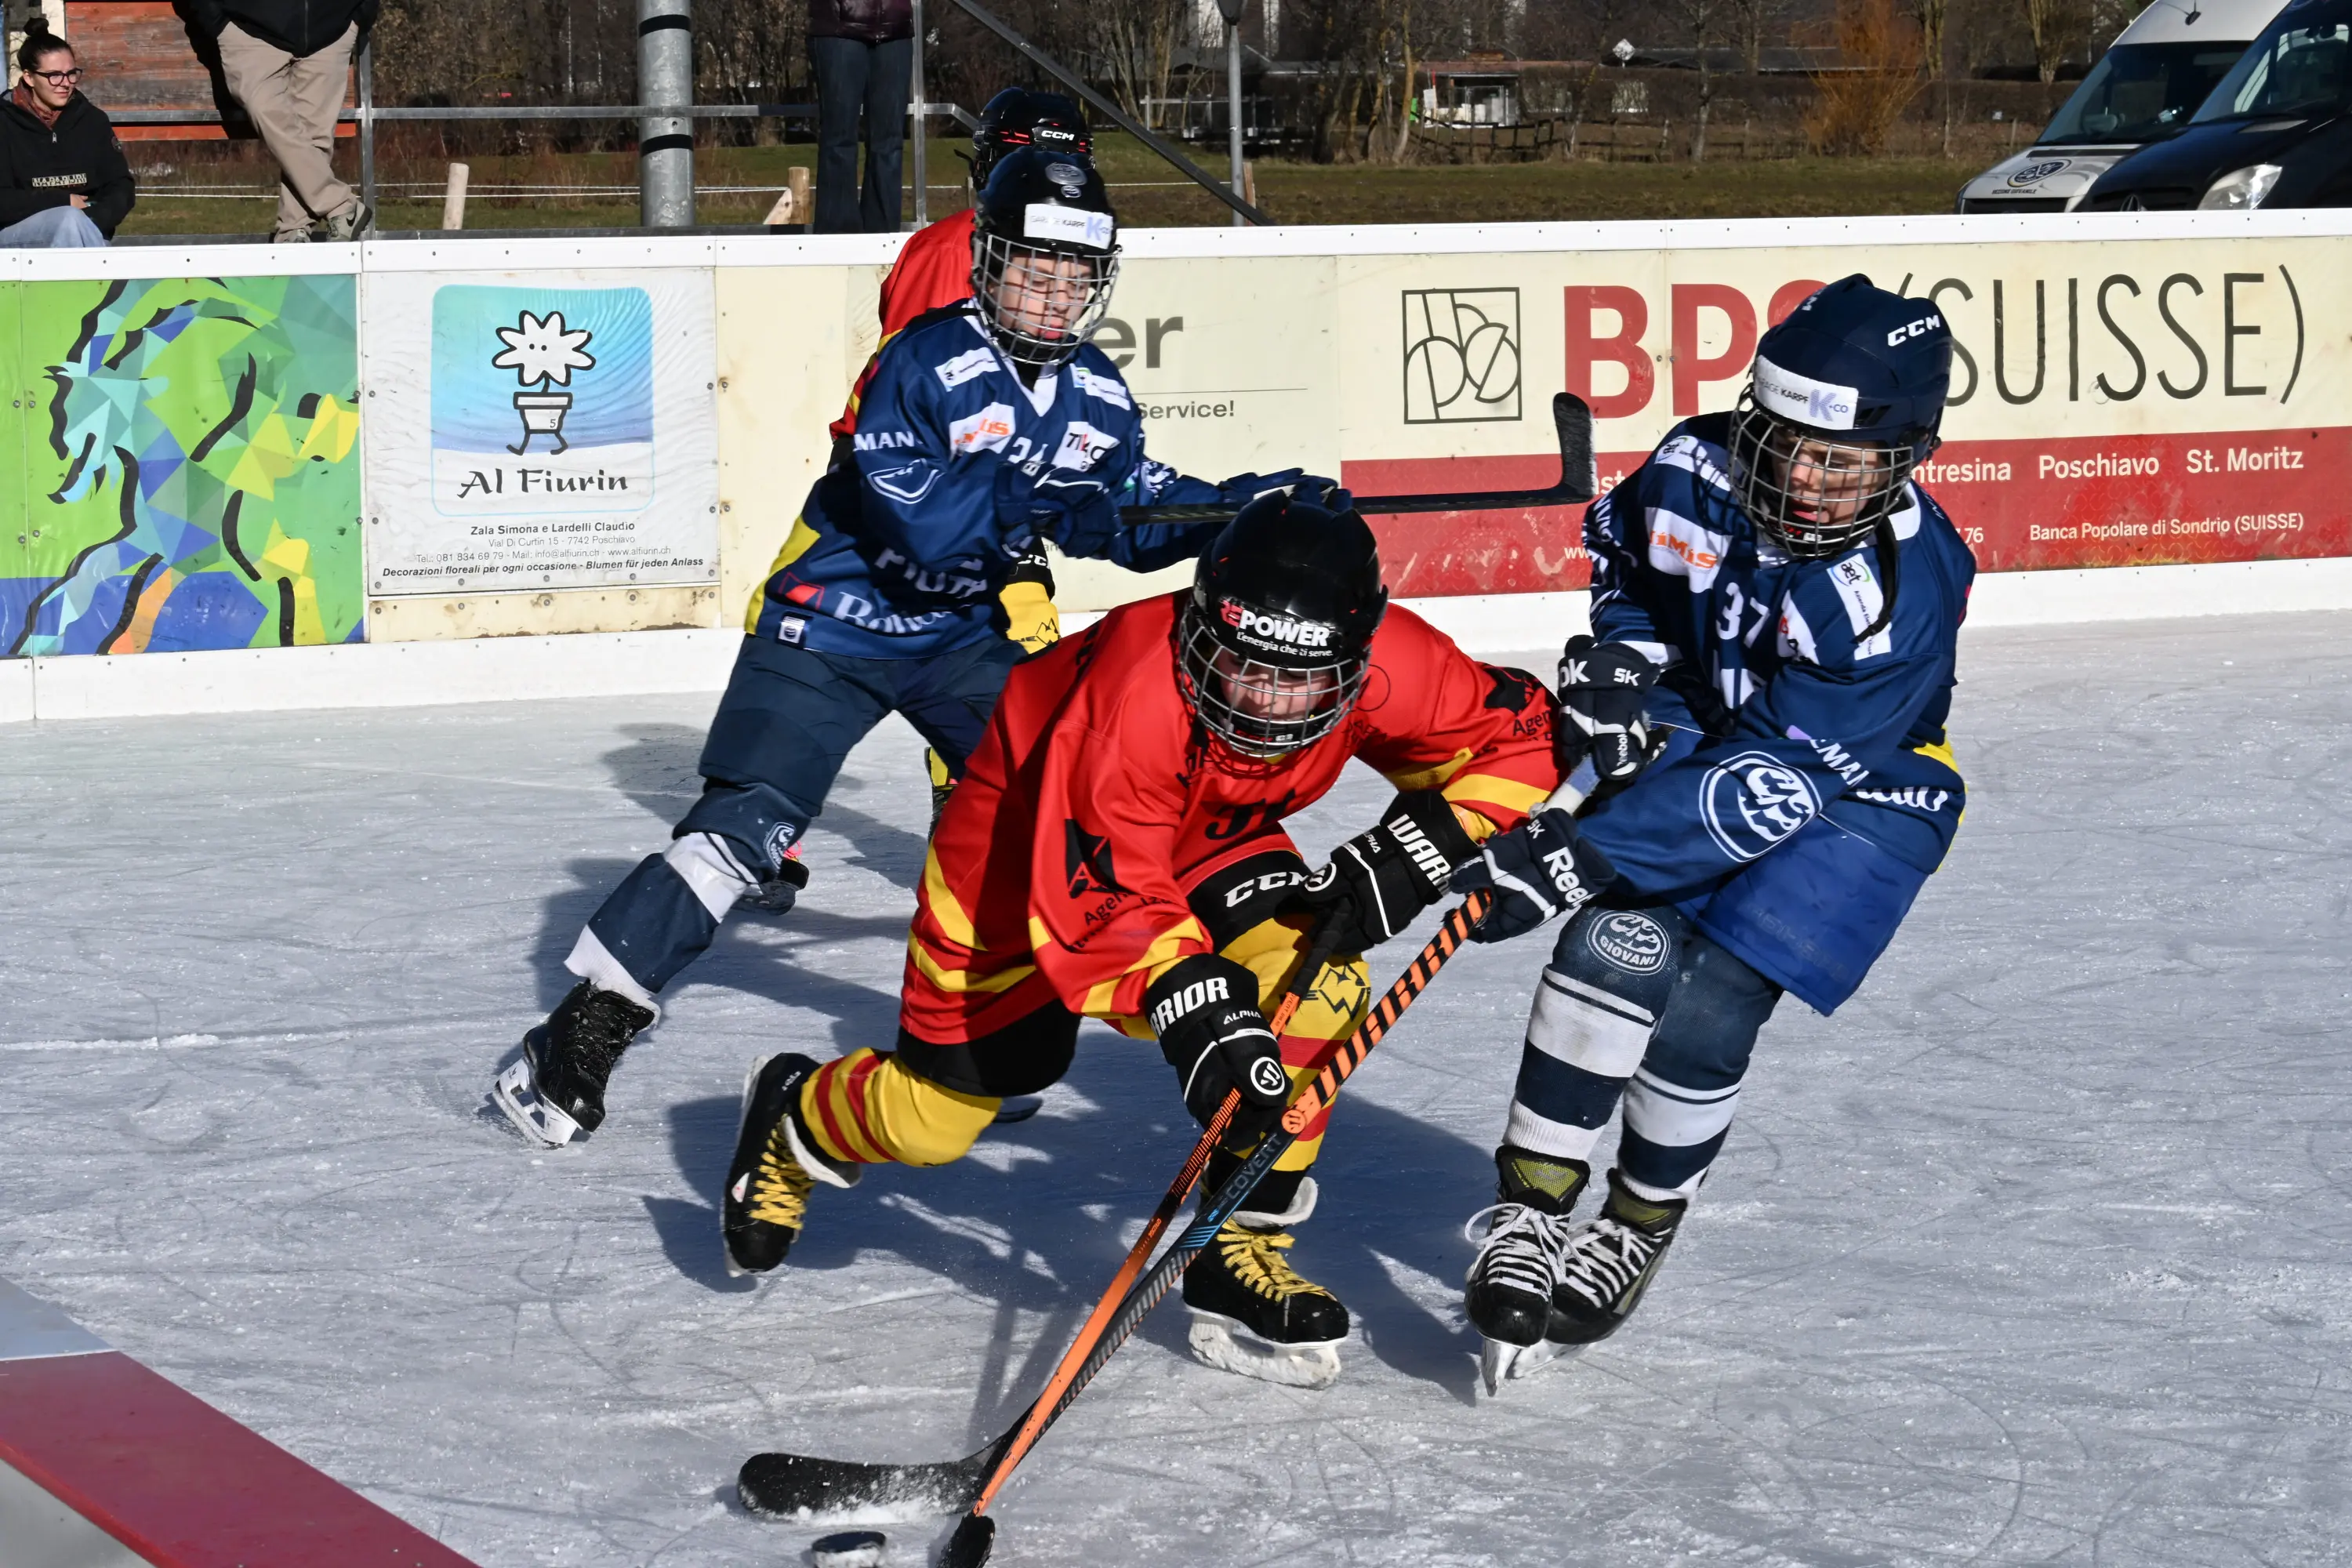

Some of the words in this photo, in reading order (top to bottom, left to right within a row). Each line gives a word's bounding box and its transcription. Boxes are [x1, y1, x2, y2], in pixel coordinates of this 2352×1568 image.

[1041, 130, 1075, 140] CCM
[1564, 279, 1828, 419] BP
[1897, 263, 2304, 406] SUISSE)
[1887, 314, 1940, 347] CCM
[1780, 388, 1809, 404] KARPF
[550, 419, 557, 428] 5
[1911, 458, 2011, 483] ntresina
[2038, 452, 2160, 481] Poschiavo
[2186, 448, 2220, 474] St.
[2227, 446, 2303, 471] Moritz
[456, 468, 503, 499] Al
[517, 468, 628, 493] Fiurin
[470, 526, 494, 535] Zala
[498, 524, 539, 535] Simona
[552, 523, 591, 533] Lardelli
[594, 521, 635, 532] Claudio
[1964, 527, 1984, 543] 76
[2030, 524, 2078, 541] Banca
[2082, 521, 2148, 541] Popolare
[2152, 521, 2167, 535] di
[2170, 517, 2230, 535] Sondrio
[2235, 512, 2304, 533] (SUISSE)
[436, 554, 453, 562] 081
[457, 553, 475, 561] 834
[477, 552, 490, 561] 69
[493, 551, 504, 560] 79
[512, 550, 532, 559] Mail:
[535, 549, 600, 559] info@alfiurin.ch
[608, 546, 671, 557] www.alfiurin.ch
[488, 539, 503, 547] Vial
[506, 538, 516, 546] Di
[518, 537, 545, 546] Curtin
[548, 537, 558, 546] 15
[568, 536, 590, 545] 7742
[592, 535, 635, 544] Poschiavo
[383, 567, 442, 577] Decorazioni
[446, 565, 480, 575] floreali
[483, 565, 499, 575] per
[503, 564, 524, 574] ogni
[527, 561, 577, 572] occasione
[586, 560, 622, 570] Blumen
[626, 559, 639, 568] für
[641, 558, 668, 569] jeden
[671, 557, 703, 567] Anlass
[1715, 583, 1769, 648] 37
[1236, 632, 1279, 652] L'energia
[1279, 644, 1298, 655] che
[1224, 872, 1308, 908] CCM
[1599, 935, 1656, 966] GIOVANI
[1150, 977, 1230, 1037] RRIOR
[1223, 1010, 1261, 1025] ALPHA
[1225, 1133, 1281, 1200] COVERT
